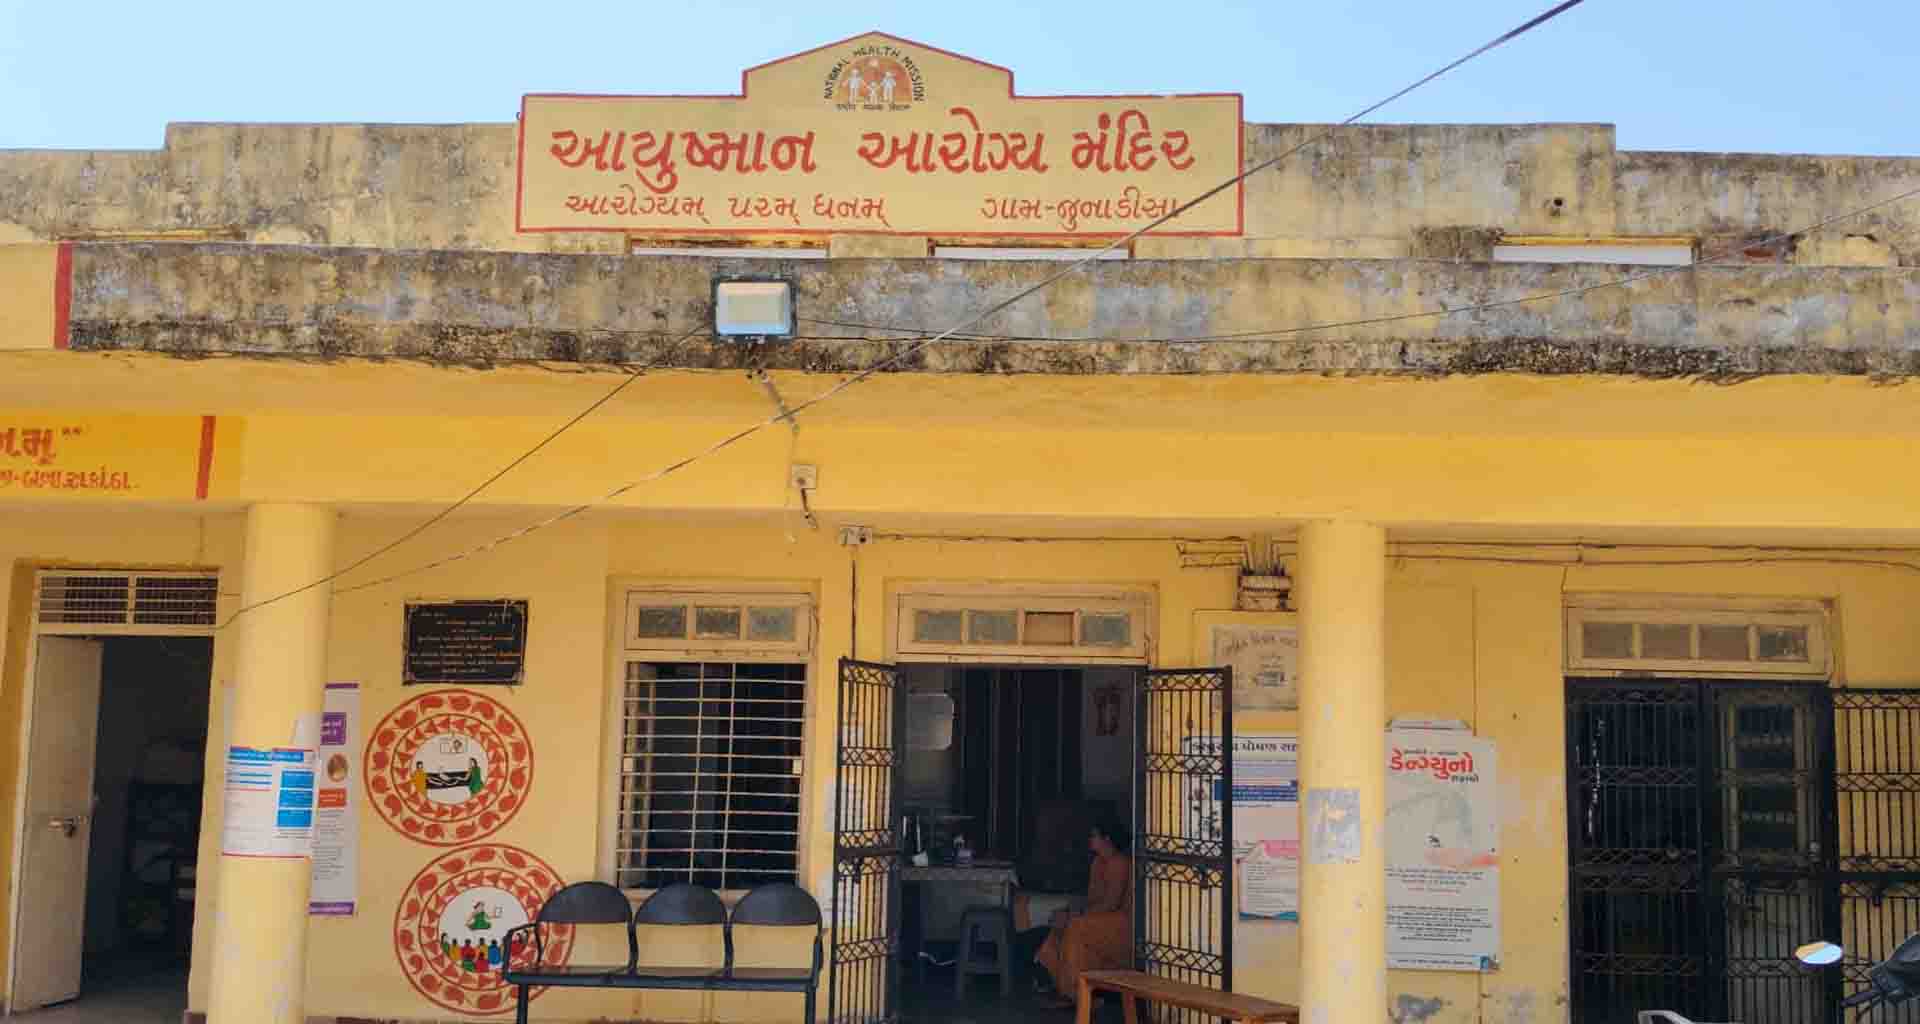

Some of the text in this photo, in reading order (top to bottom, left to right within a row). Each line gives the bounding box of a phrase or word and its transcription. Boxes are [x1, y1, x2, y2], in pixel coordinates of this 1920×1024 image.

[853, 45, 901, 57] HEALTH
[901, 56, 925, 102] MISSION
[549, 106, 1196, 194] આયુષ્માન આરોગ્ય મંદિર
[564, 183, 711, 224] આરોગ્યમ્
[728, 196, 802, 225] પરમ્
[812, 192, 892, 228] ધનમ્
